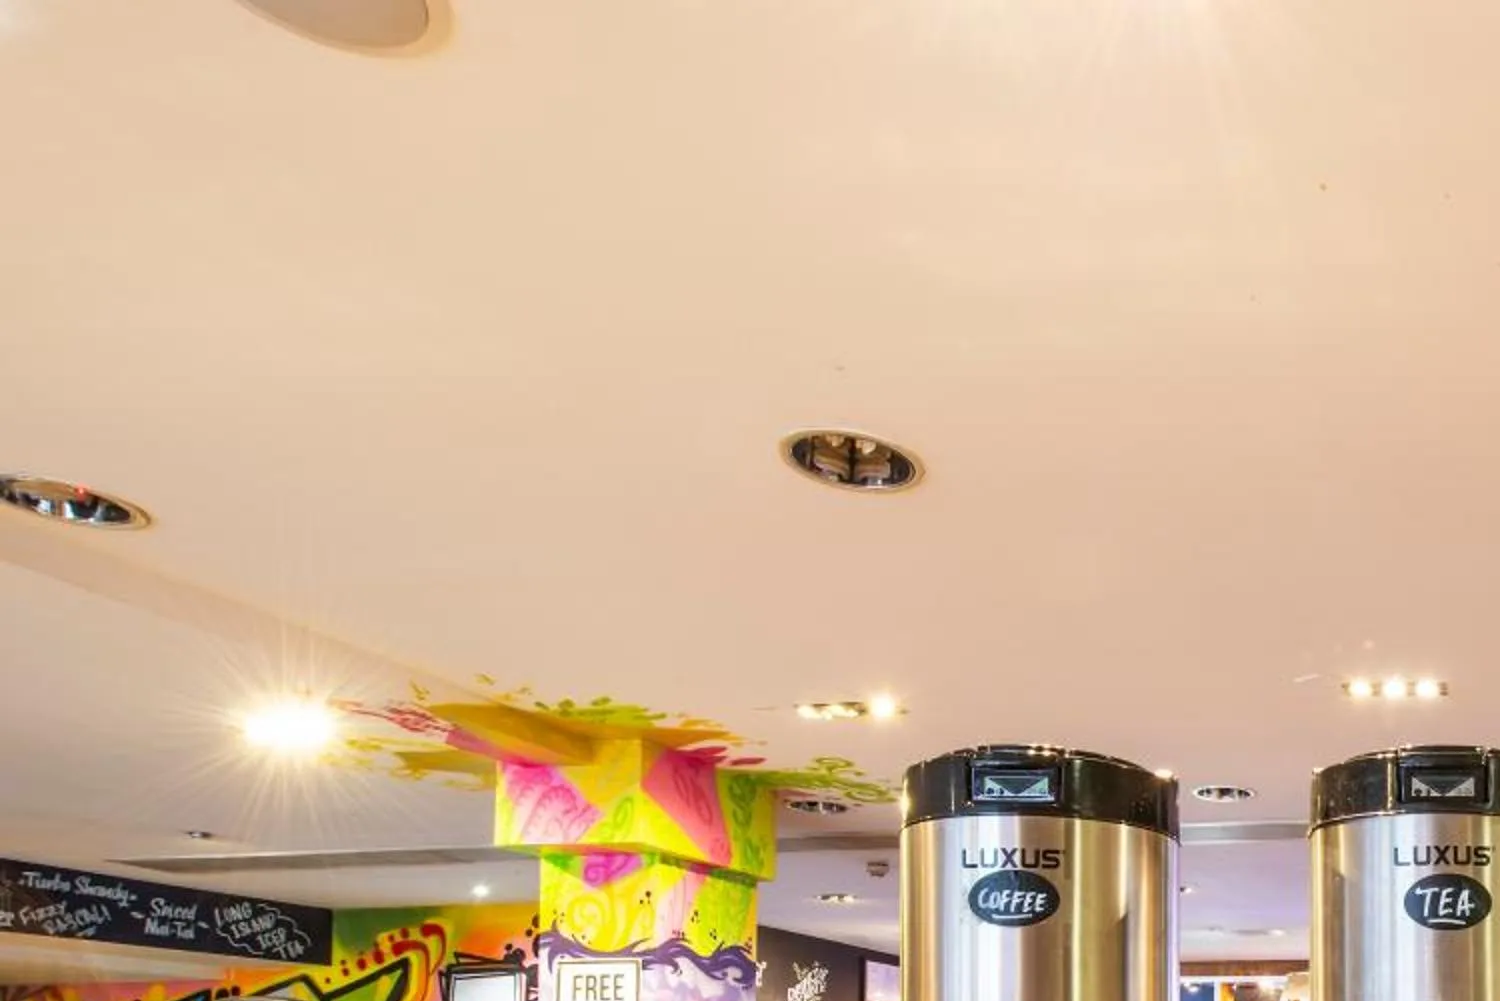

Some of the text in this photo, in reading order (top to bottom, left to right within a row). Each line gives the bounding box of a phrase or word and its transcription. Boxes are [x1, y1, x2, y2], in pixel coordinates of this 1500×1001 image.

[961, 847, 1061, 869] LUXUS
[1393, 845, 1491, 866] LUXUS
[977, 887, 1047, 913] COFFEE
[1414, 887, 1475, 917] TEA
[572, 973, 625, 1001] FREE
